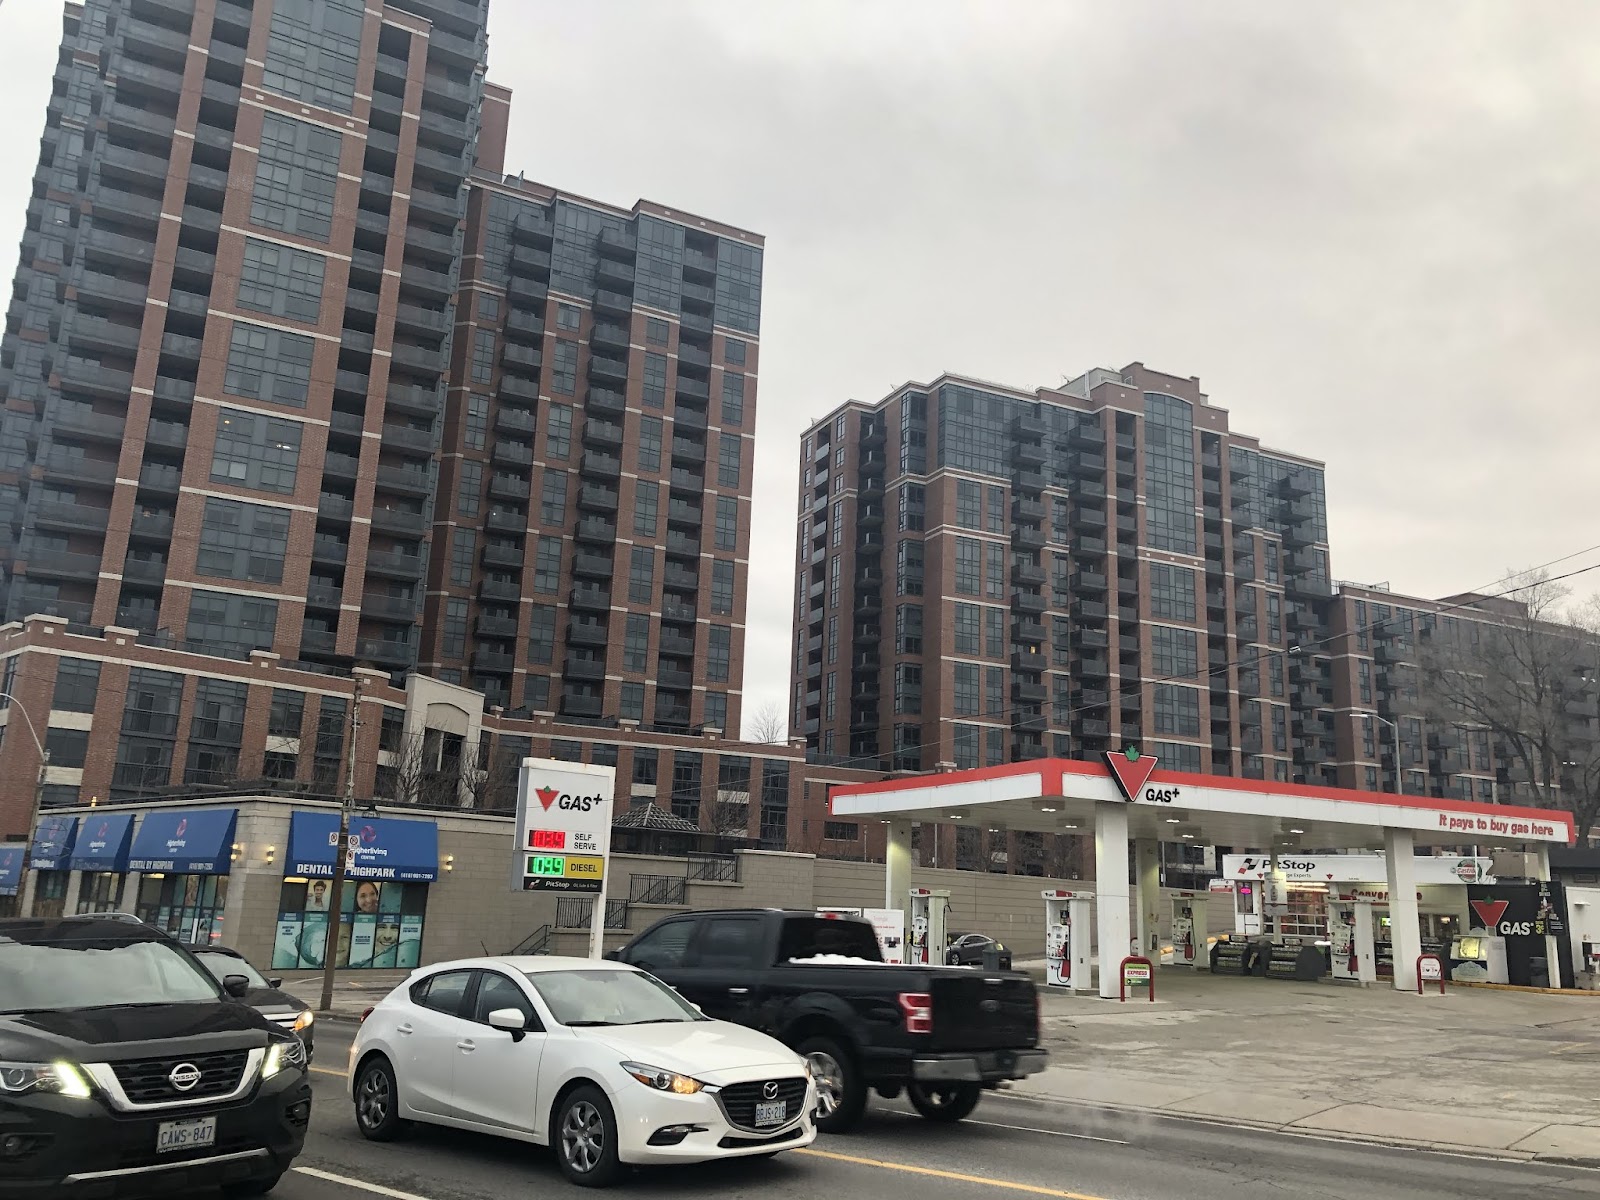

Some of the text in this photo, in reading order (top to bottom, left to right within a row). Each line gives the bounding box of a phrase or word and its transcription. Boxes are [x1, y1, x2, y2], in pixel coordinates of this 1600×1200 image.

[1146, 788, 1180, 803] GAS+
[559, 794, 603, 812] GAS+
[1439, 814, 1554, 836] It pays to buy gas here
[574, 833, 593, 841] SELF
[574, 842, 597, 851] SERVE
[296, 864, 333, 875] DENTAL
[350, 866, 396, 878] HIGHPARK
[570, 863, 598, 873] DIESEL
[1262, 859, 1316, 872] PtStop
[545, 880, 571, 889] PitStop
